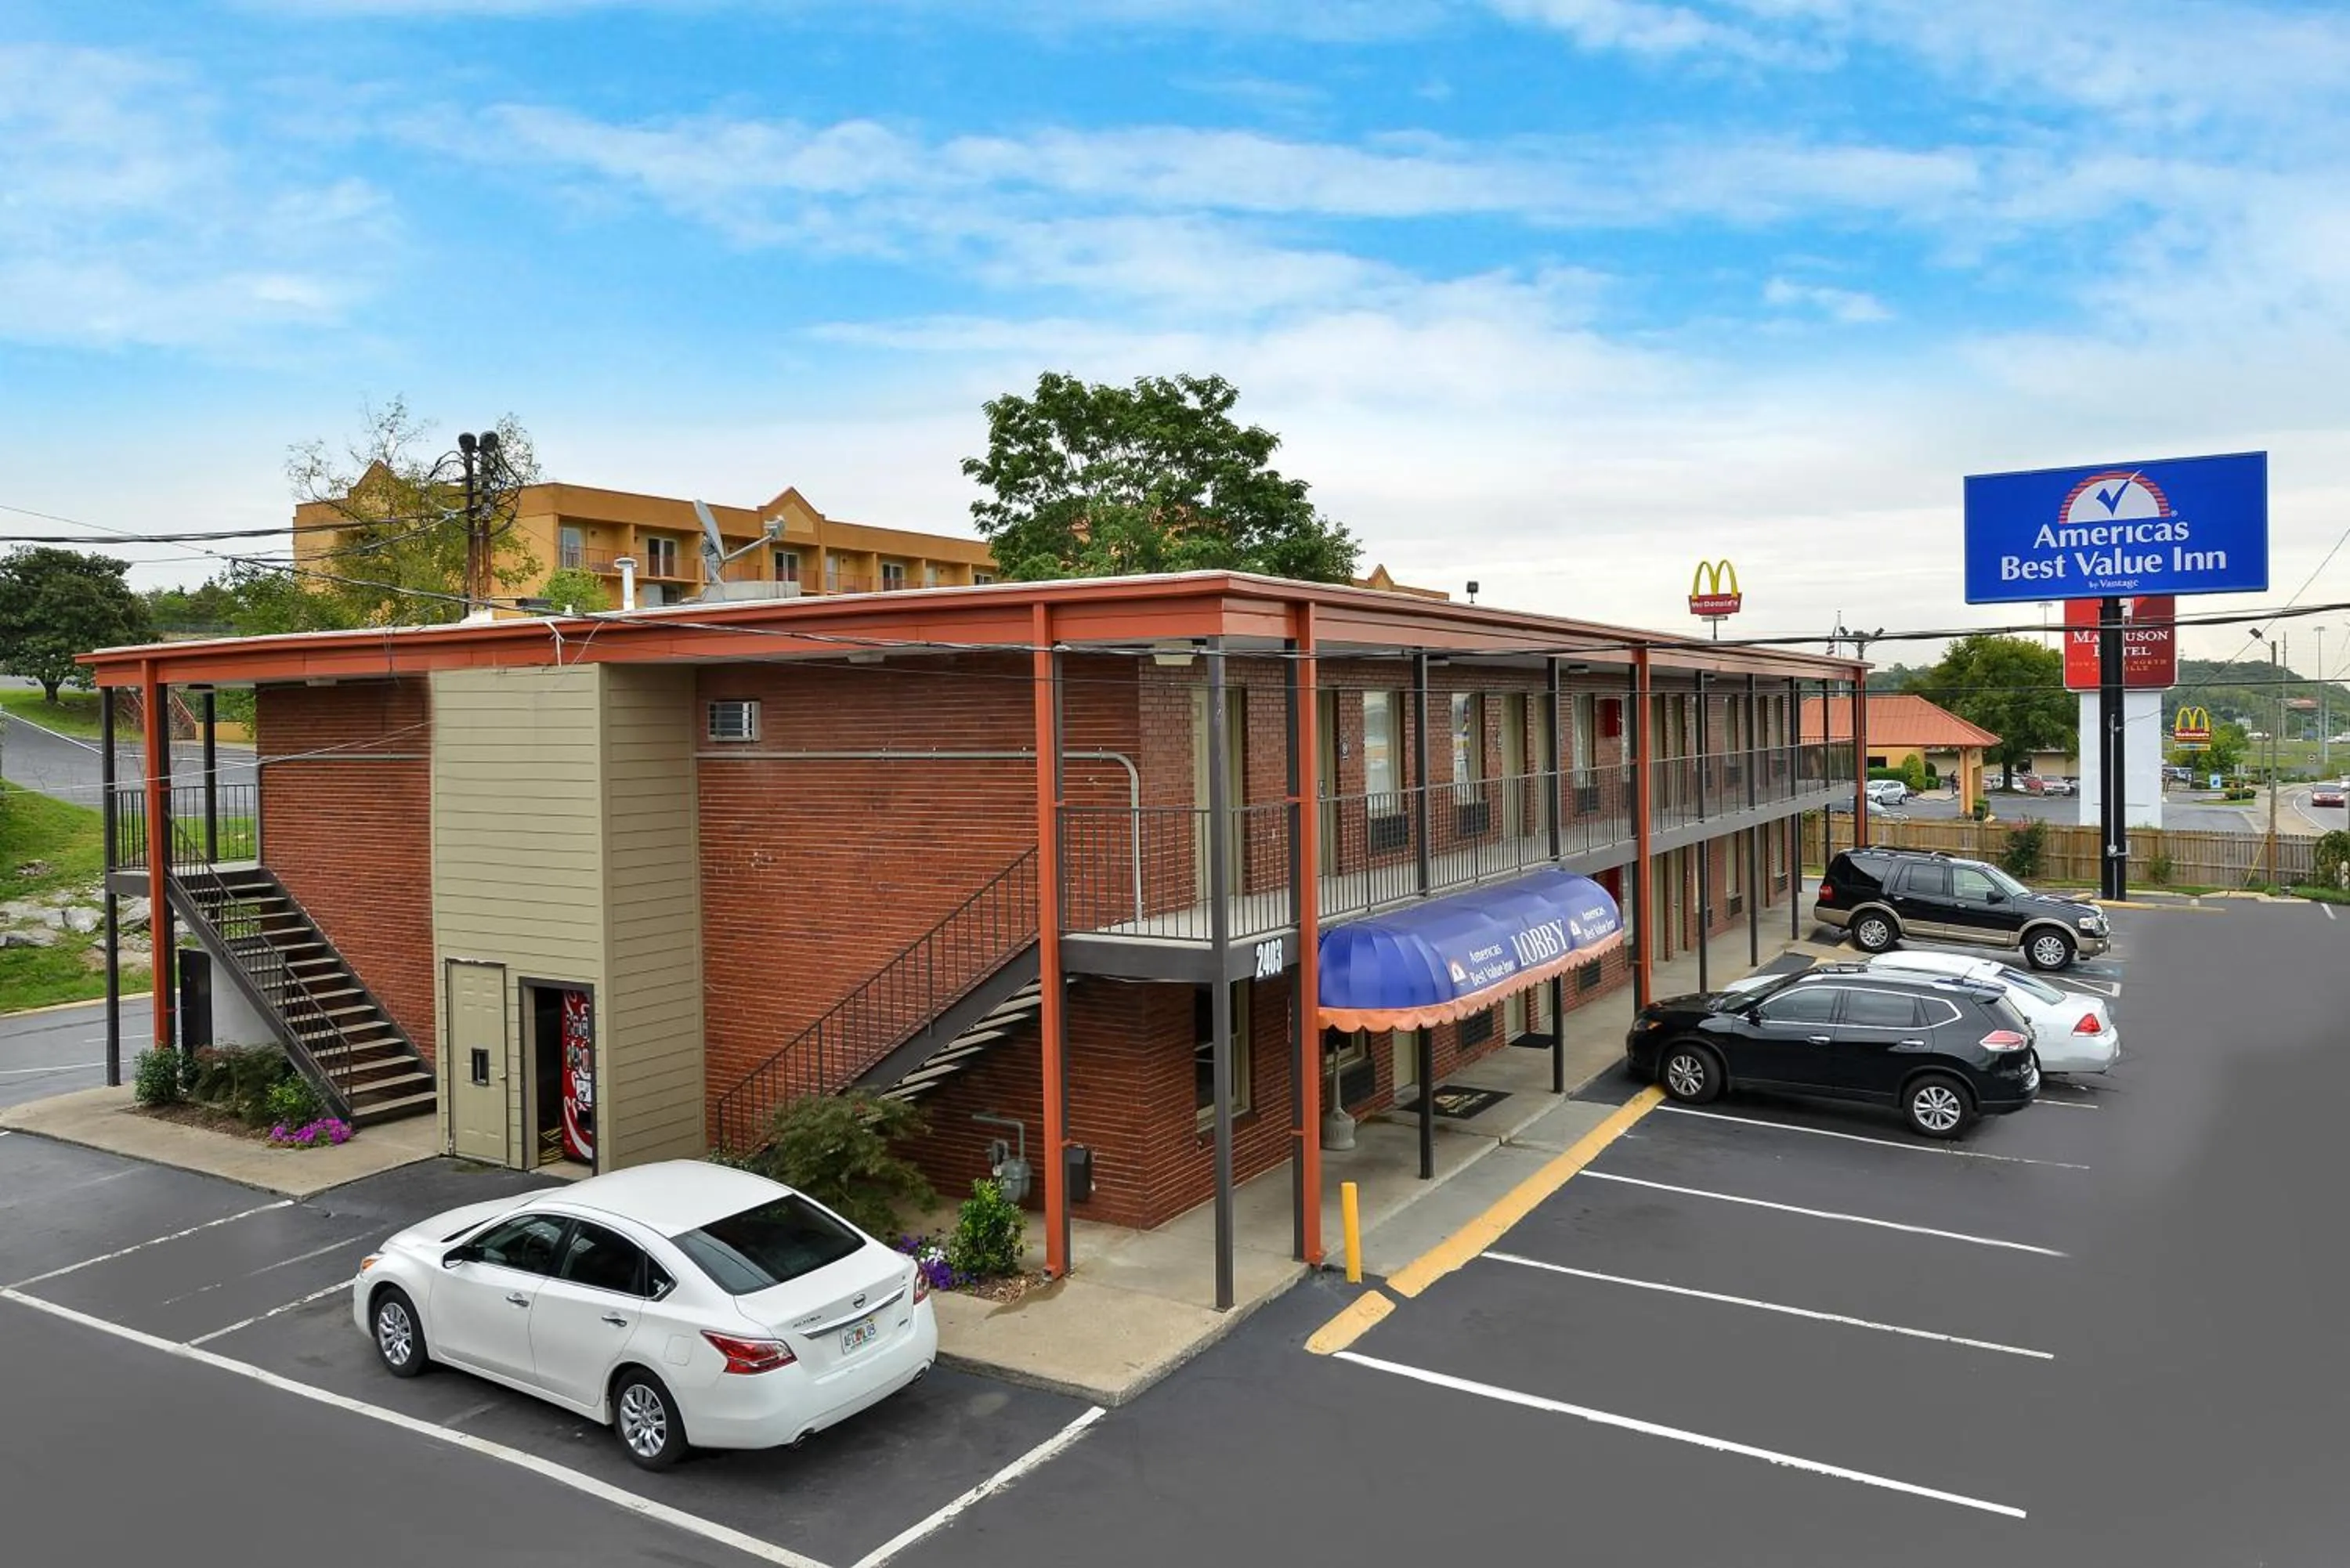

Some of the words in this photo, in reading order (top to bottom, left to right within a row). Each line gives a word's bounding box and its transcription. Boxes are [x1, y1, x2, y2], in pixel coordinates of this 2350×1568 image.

[2033, 520, 2189, 548] Americas
[2001, 554, 2066, 580] Best
[2074, 547, 2163, 576] Value
[2173, 546, 2227, 573] Inn
[2099, 580, 2139, 589] Vantage
[2072, 630, 2169, 643] MAUSON
[1256, 938, 1282, 978] 2403
[1509, 919, 1567, 967] LOBBY
